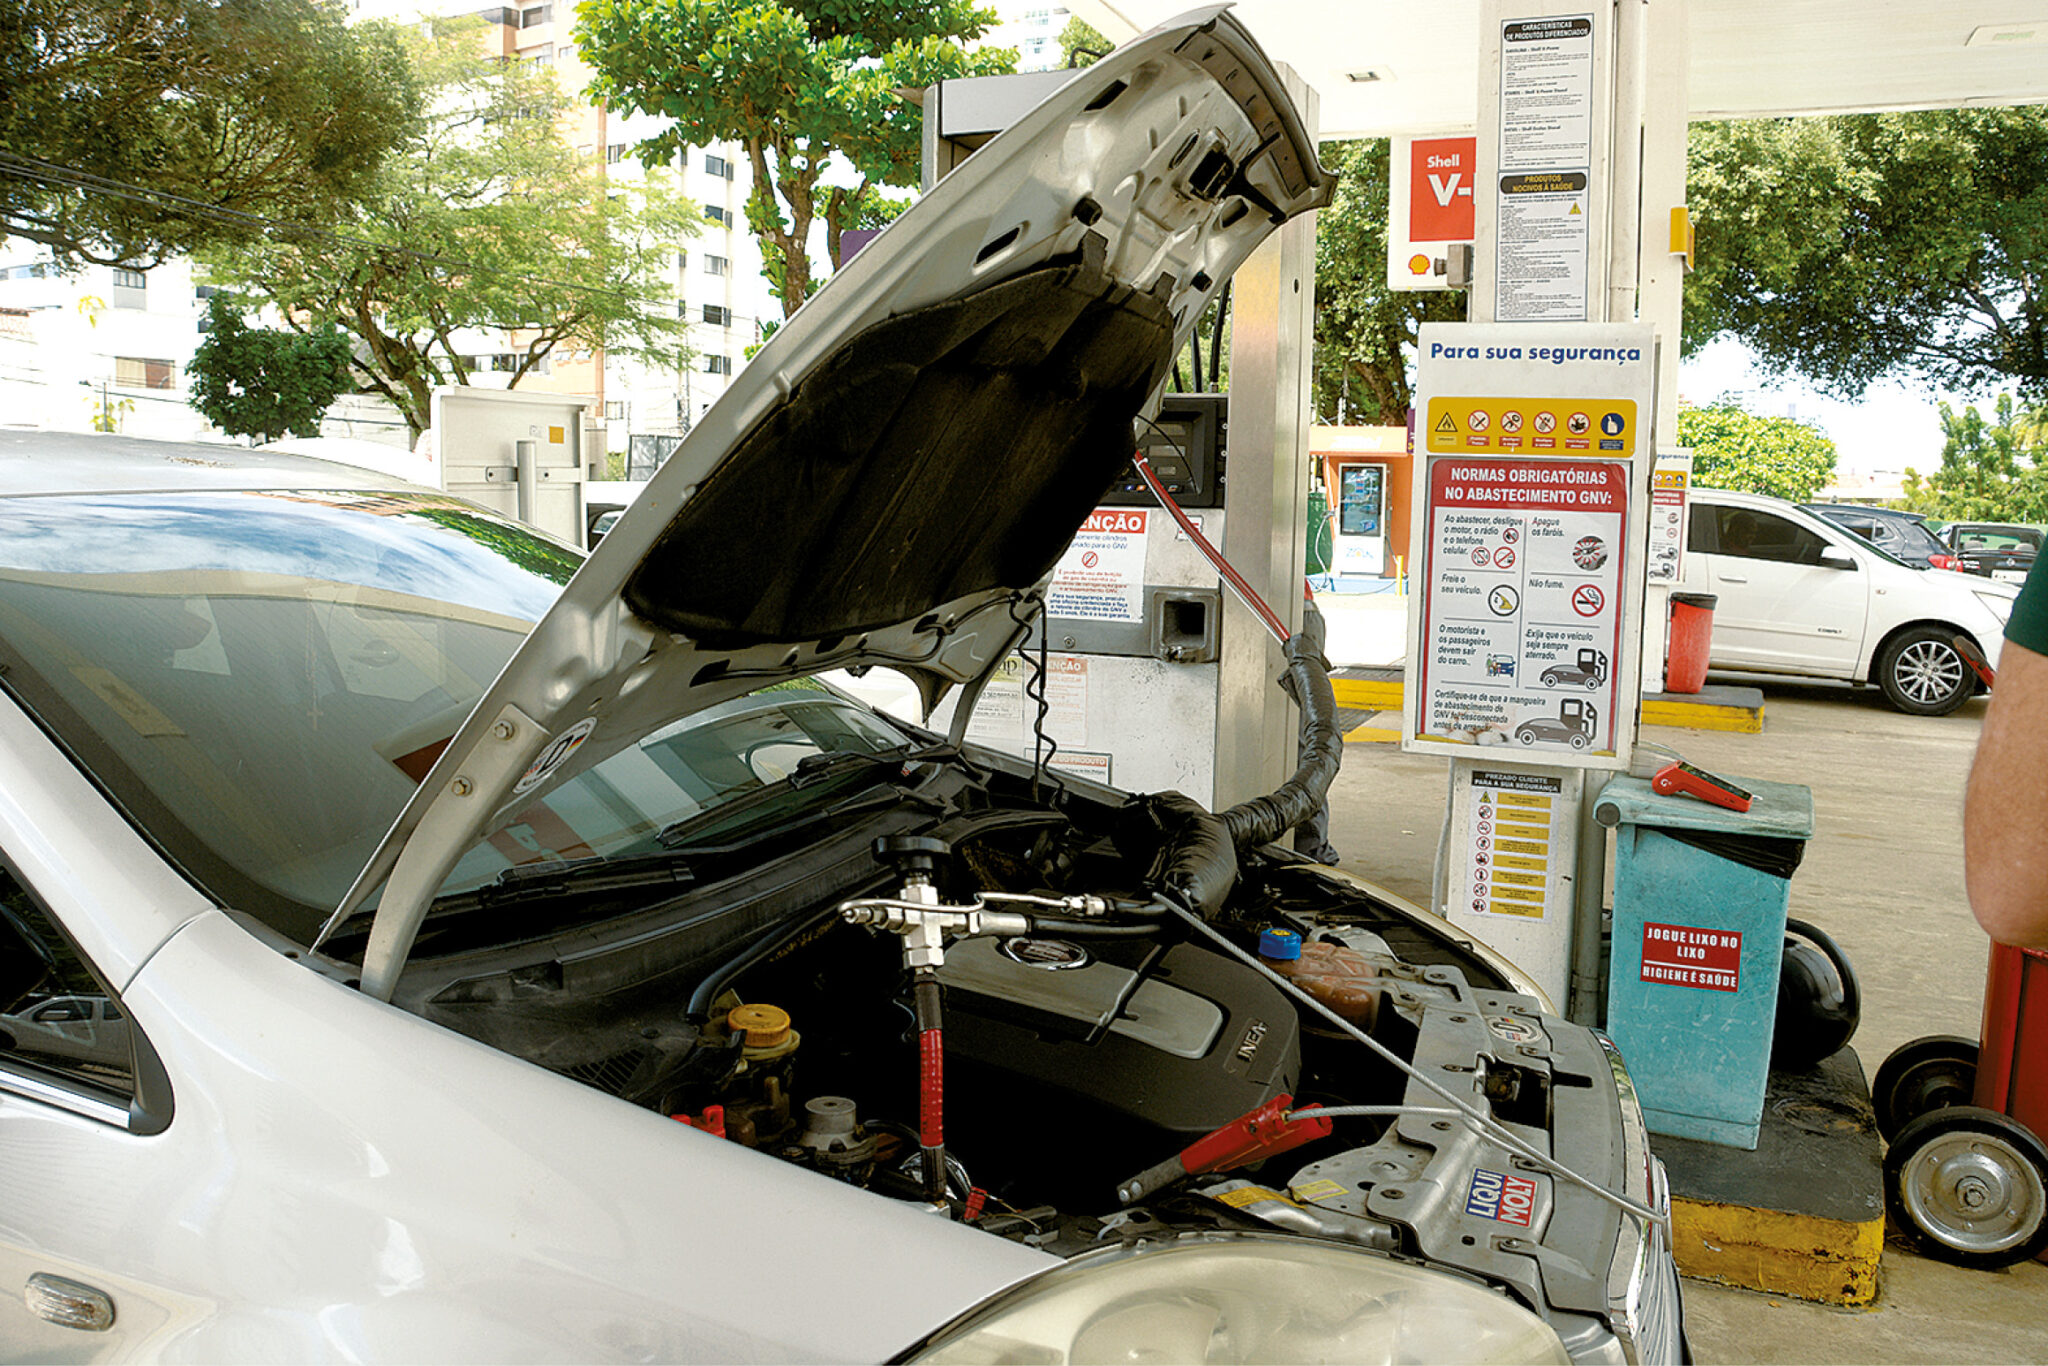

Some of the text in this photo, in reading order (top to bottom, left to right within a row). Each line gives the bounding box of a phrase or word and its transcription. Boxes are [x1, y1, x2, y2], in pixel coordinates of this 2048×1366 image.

[1515, 31, 1543, 39] PRODUTOS
[1545, 28, 1588, 37] DIFERENCIADOS
[1427, 154, 1459, 168] Shell
[1525, 174, 1561, 182] PRODUTOS
[1428, 174, 1476, 206] V-
[1513, 184, 1542, 192] NOCIVOS
[1550, 182, 1573, 190] SAÚDE
[1431, 343, 1640, 366] Para sua segurança
[1452, 468, 1607, 484] NORMAS OBRIGATÓRIAS
[1445, 487, 1612, 504] NO ABASTECIMENTO GNV:
[1080, 514, 1142, 532] NÇÃO
[1445, 515, 1522, 526] Ao abastecer, desligue
[1532, 517, 1560, 527] Apague
[1450, 526, 1472, 534] motor,
[1456, 536, 1484, 544] telefone
[1442, 574, 1459, 583] Freie
[1529, 579, 1564, 588] Não fume.
[1456, 586, 1482, 594] veículo.
[1440, 624, 1445, 632] O
[1446, 626, 1479, 635] motorista
[1526, 629, 1543, 640] Exija
[1546, 632, 1559, 640] que
[1568, 632, 1593, 641] veículo
[1449, 637, 1490, 646] passageiros
[1526, 641, 1568, 651] seja sempre
[1438, 646, 1461, 654] devem
[1438, 656, 1446, 664] do
[1526, 652, 1556, 660] aterrado.
[1435, 690, 1477, 700] Certifique-se
[1479, 693, 1487, 701] de
[1510, 696, 1545, 706] mangueira
[1445, 702, 1493, 712] abastecimento
[1434, 710, 1449, 718] GNV
[1461, 713, 1508, 723] desconectada
[1433, 721, 1451, 729] antes
[1485, 773, 1547, 784] PREZADO CLIENTE
[1516, 782, 1558, 792] SEGURANÇA
[1648, 927, 1737, 948] JOGUE LIXO NO
[1677, 946, 1705, 959] LIXO
[1643, 966, 1736, 987] HIGIENE É SAÚDE
[1468, 1170, 1503, 1218] LIQUI
[1500, 1176, 1533, 1224] MOLY
